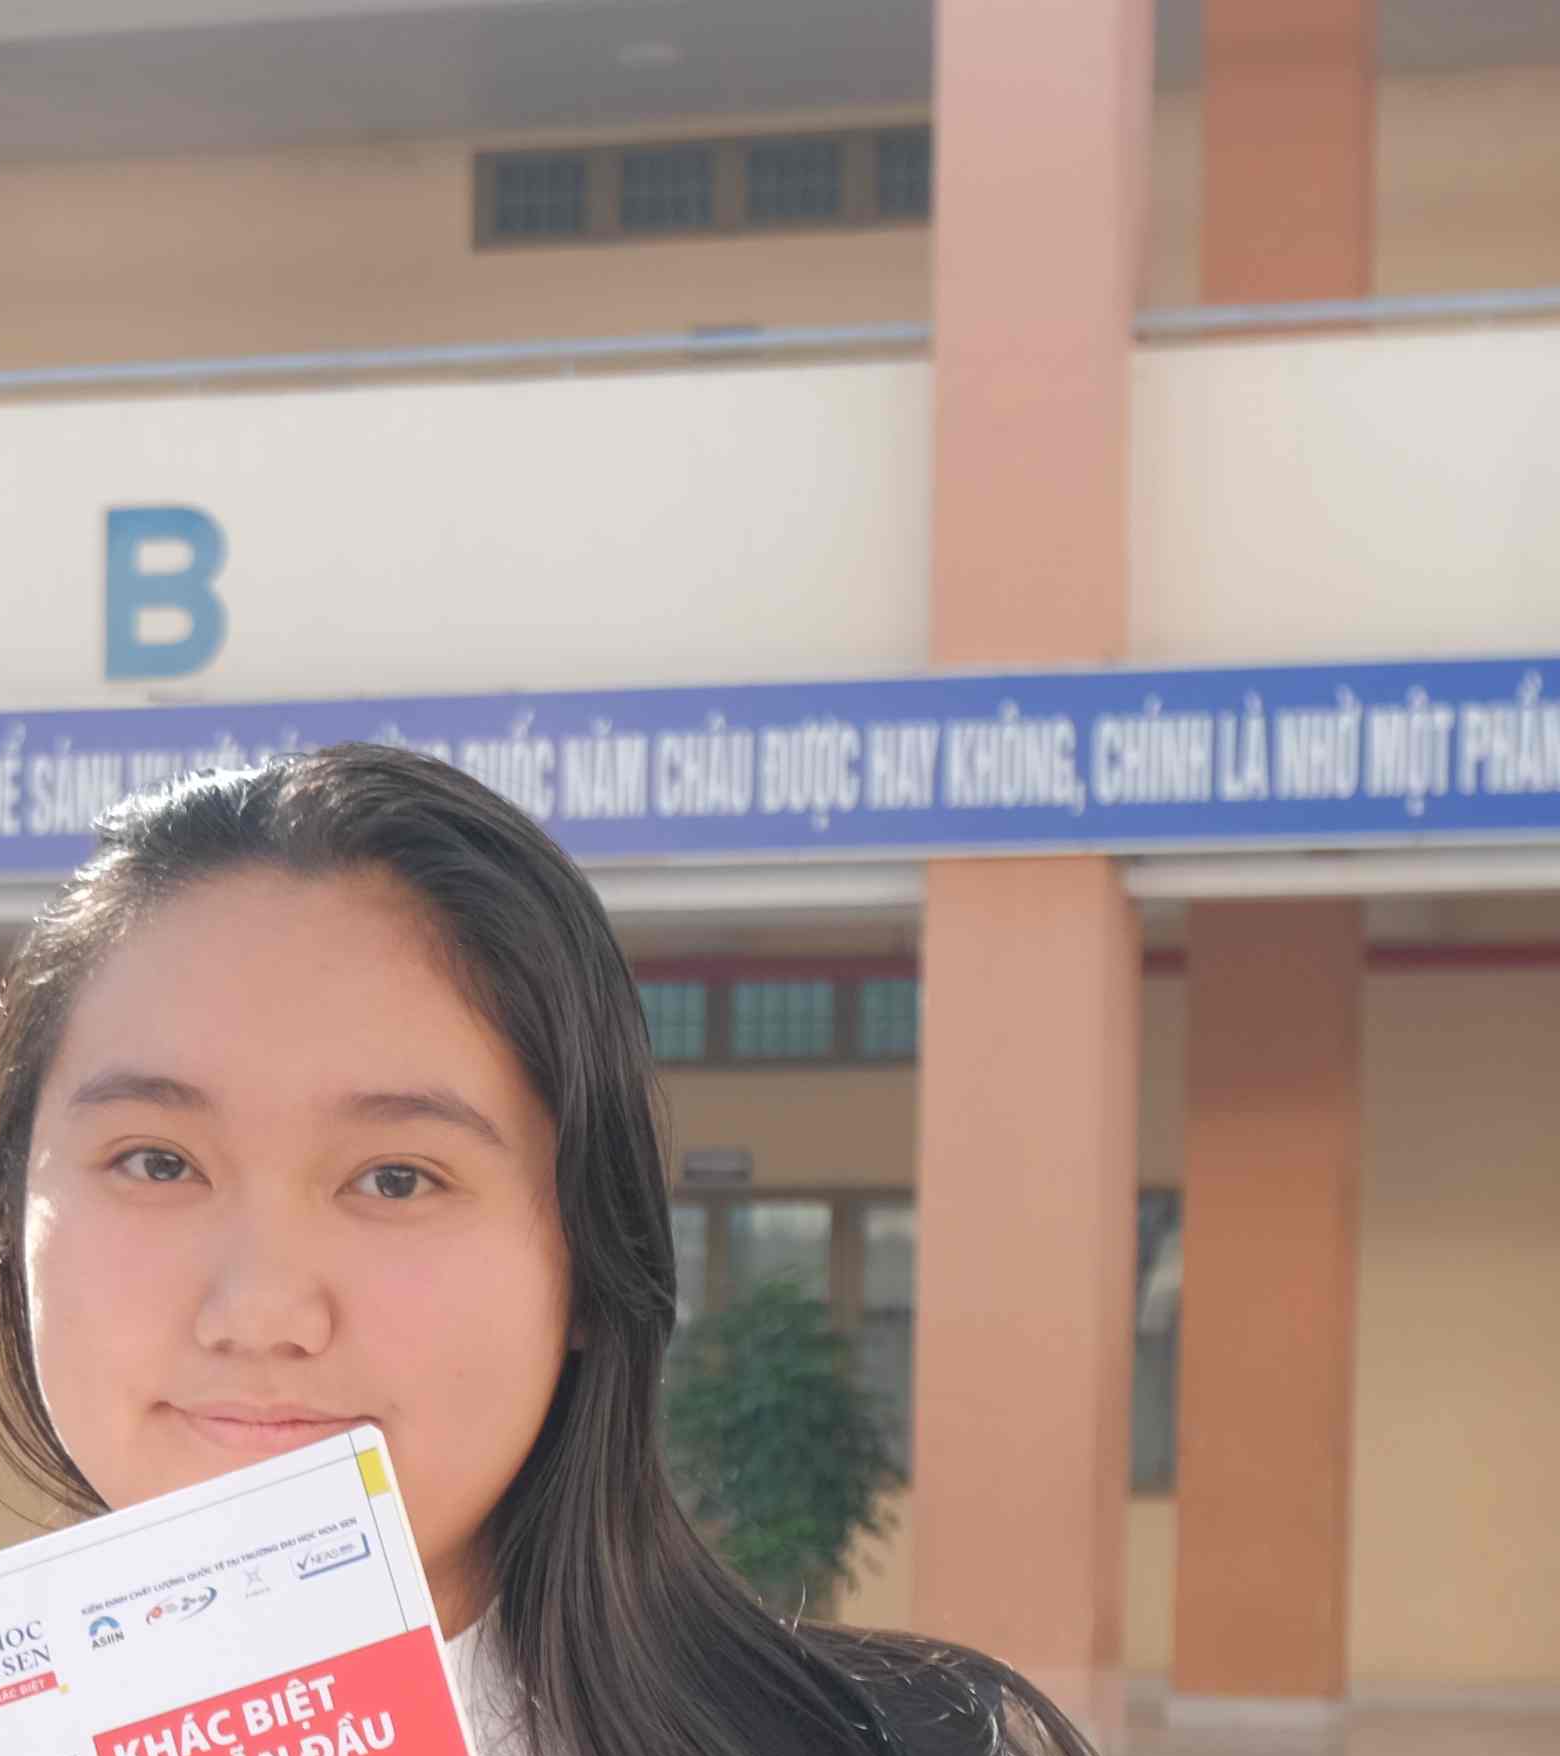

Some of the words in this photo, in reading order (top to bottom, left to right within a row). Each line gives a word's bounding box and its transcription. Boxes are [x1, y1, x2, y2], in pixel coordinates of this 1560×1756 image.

[103, 506, 230, 680] B
[562, 716, 649, 819] NĂM
[655, 711, 755, 816] CHÂU
[759, 713, 863, 831] ĐƯỢC
[866, 720, 941, 810] HAY
[943, 698, 1087, 816] KHÔNG,
[1091, 693, 1215, 806] CHÍNH
[1216, 689, 1270, 802] LÀ
[1274, 683, 1364, 801] NHỜ
[1365, 685, 1456, 816] MỘT
[1, 1645, 52, 1677] SEN
[91, 1631, 125, 1650] ASIIN
[20, 1678, 46, 1697] BIỆT
[241, 1675, 336, 1737] BIỆT
